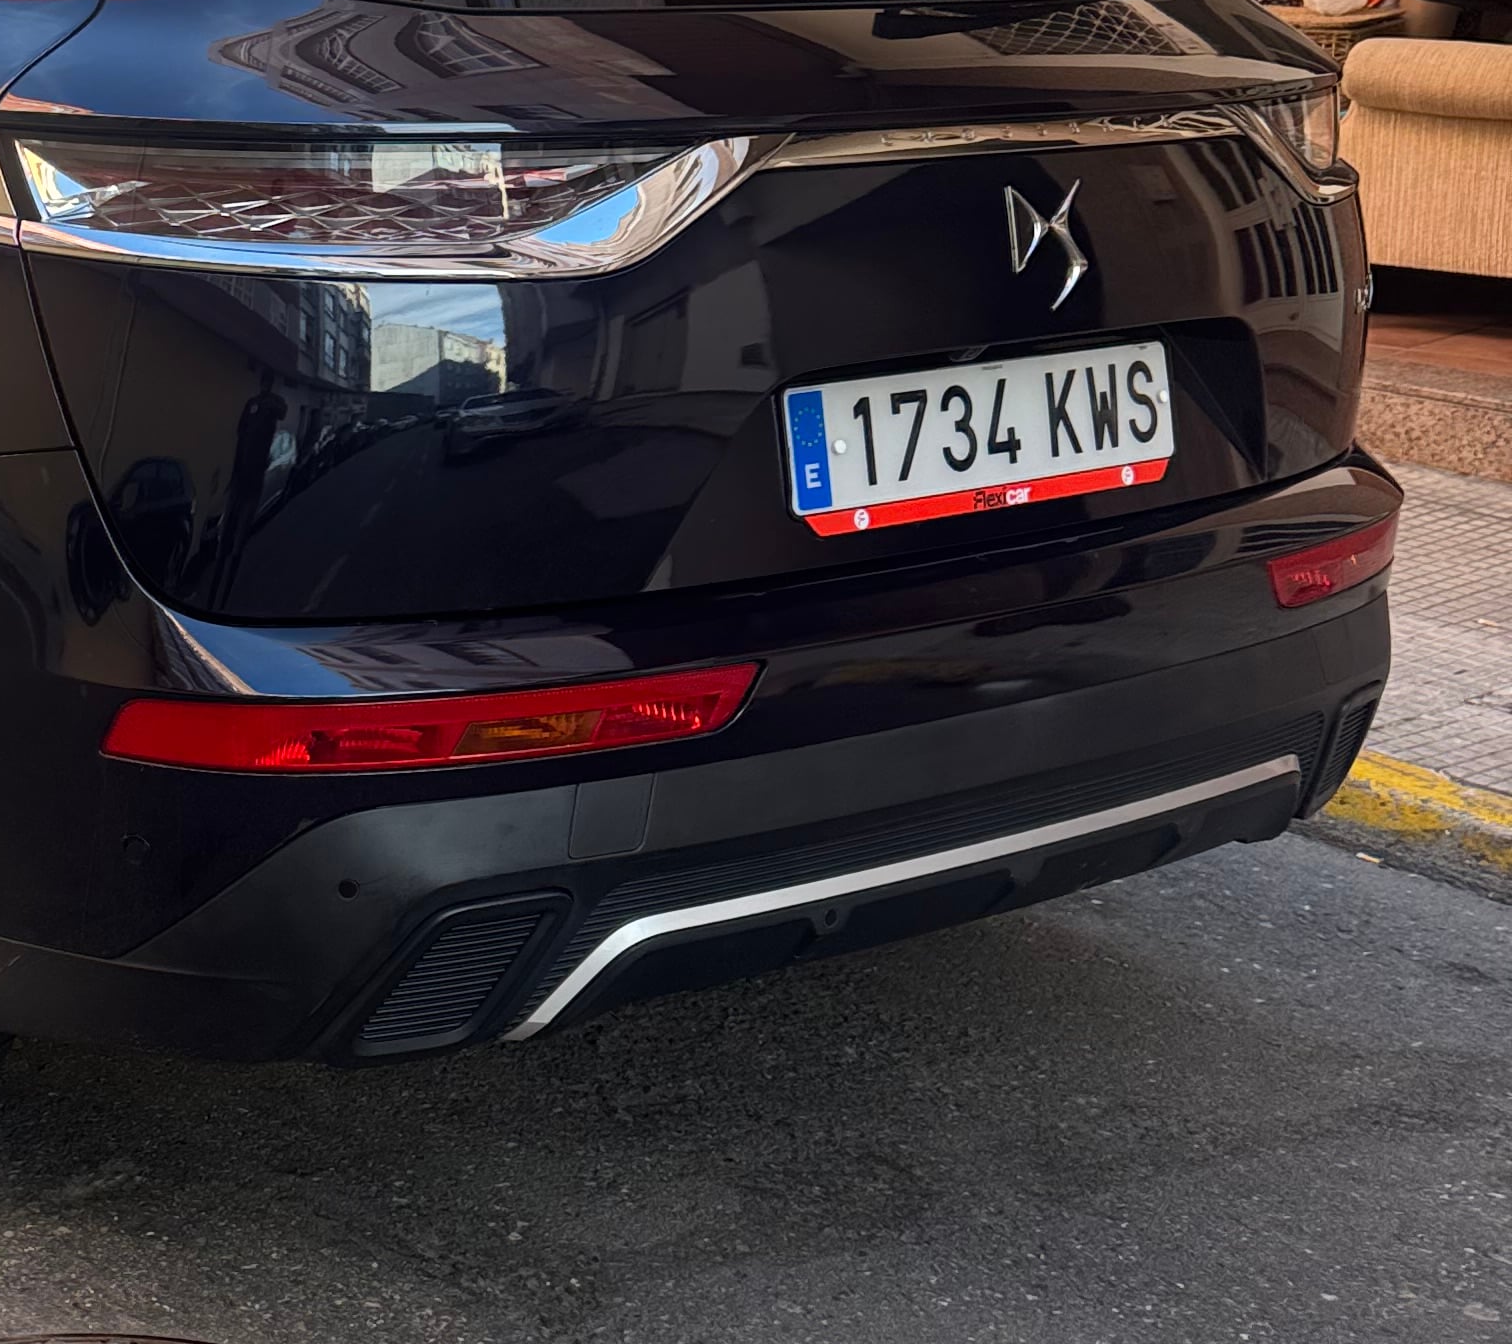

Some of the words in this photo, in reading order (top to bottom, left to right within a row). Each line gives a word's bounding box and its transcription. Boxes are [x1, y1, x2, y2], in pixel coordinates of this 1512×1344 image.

[852, 377, 1022, 487] 1734
[1044, 359, 1159, 458] KWS
[803, 461, 823, 490] E
[972, 485, 1033, 511] Flexicar
